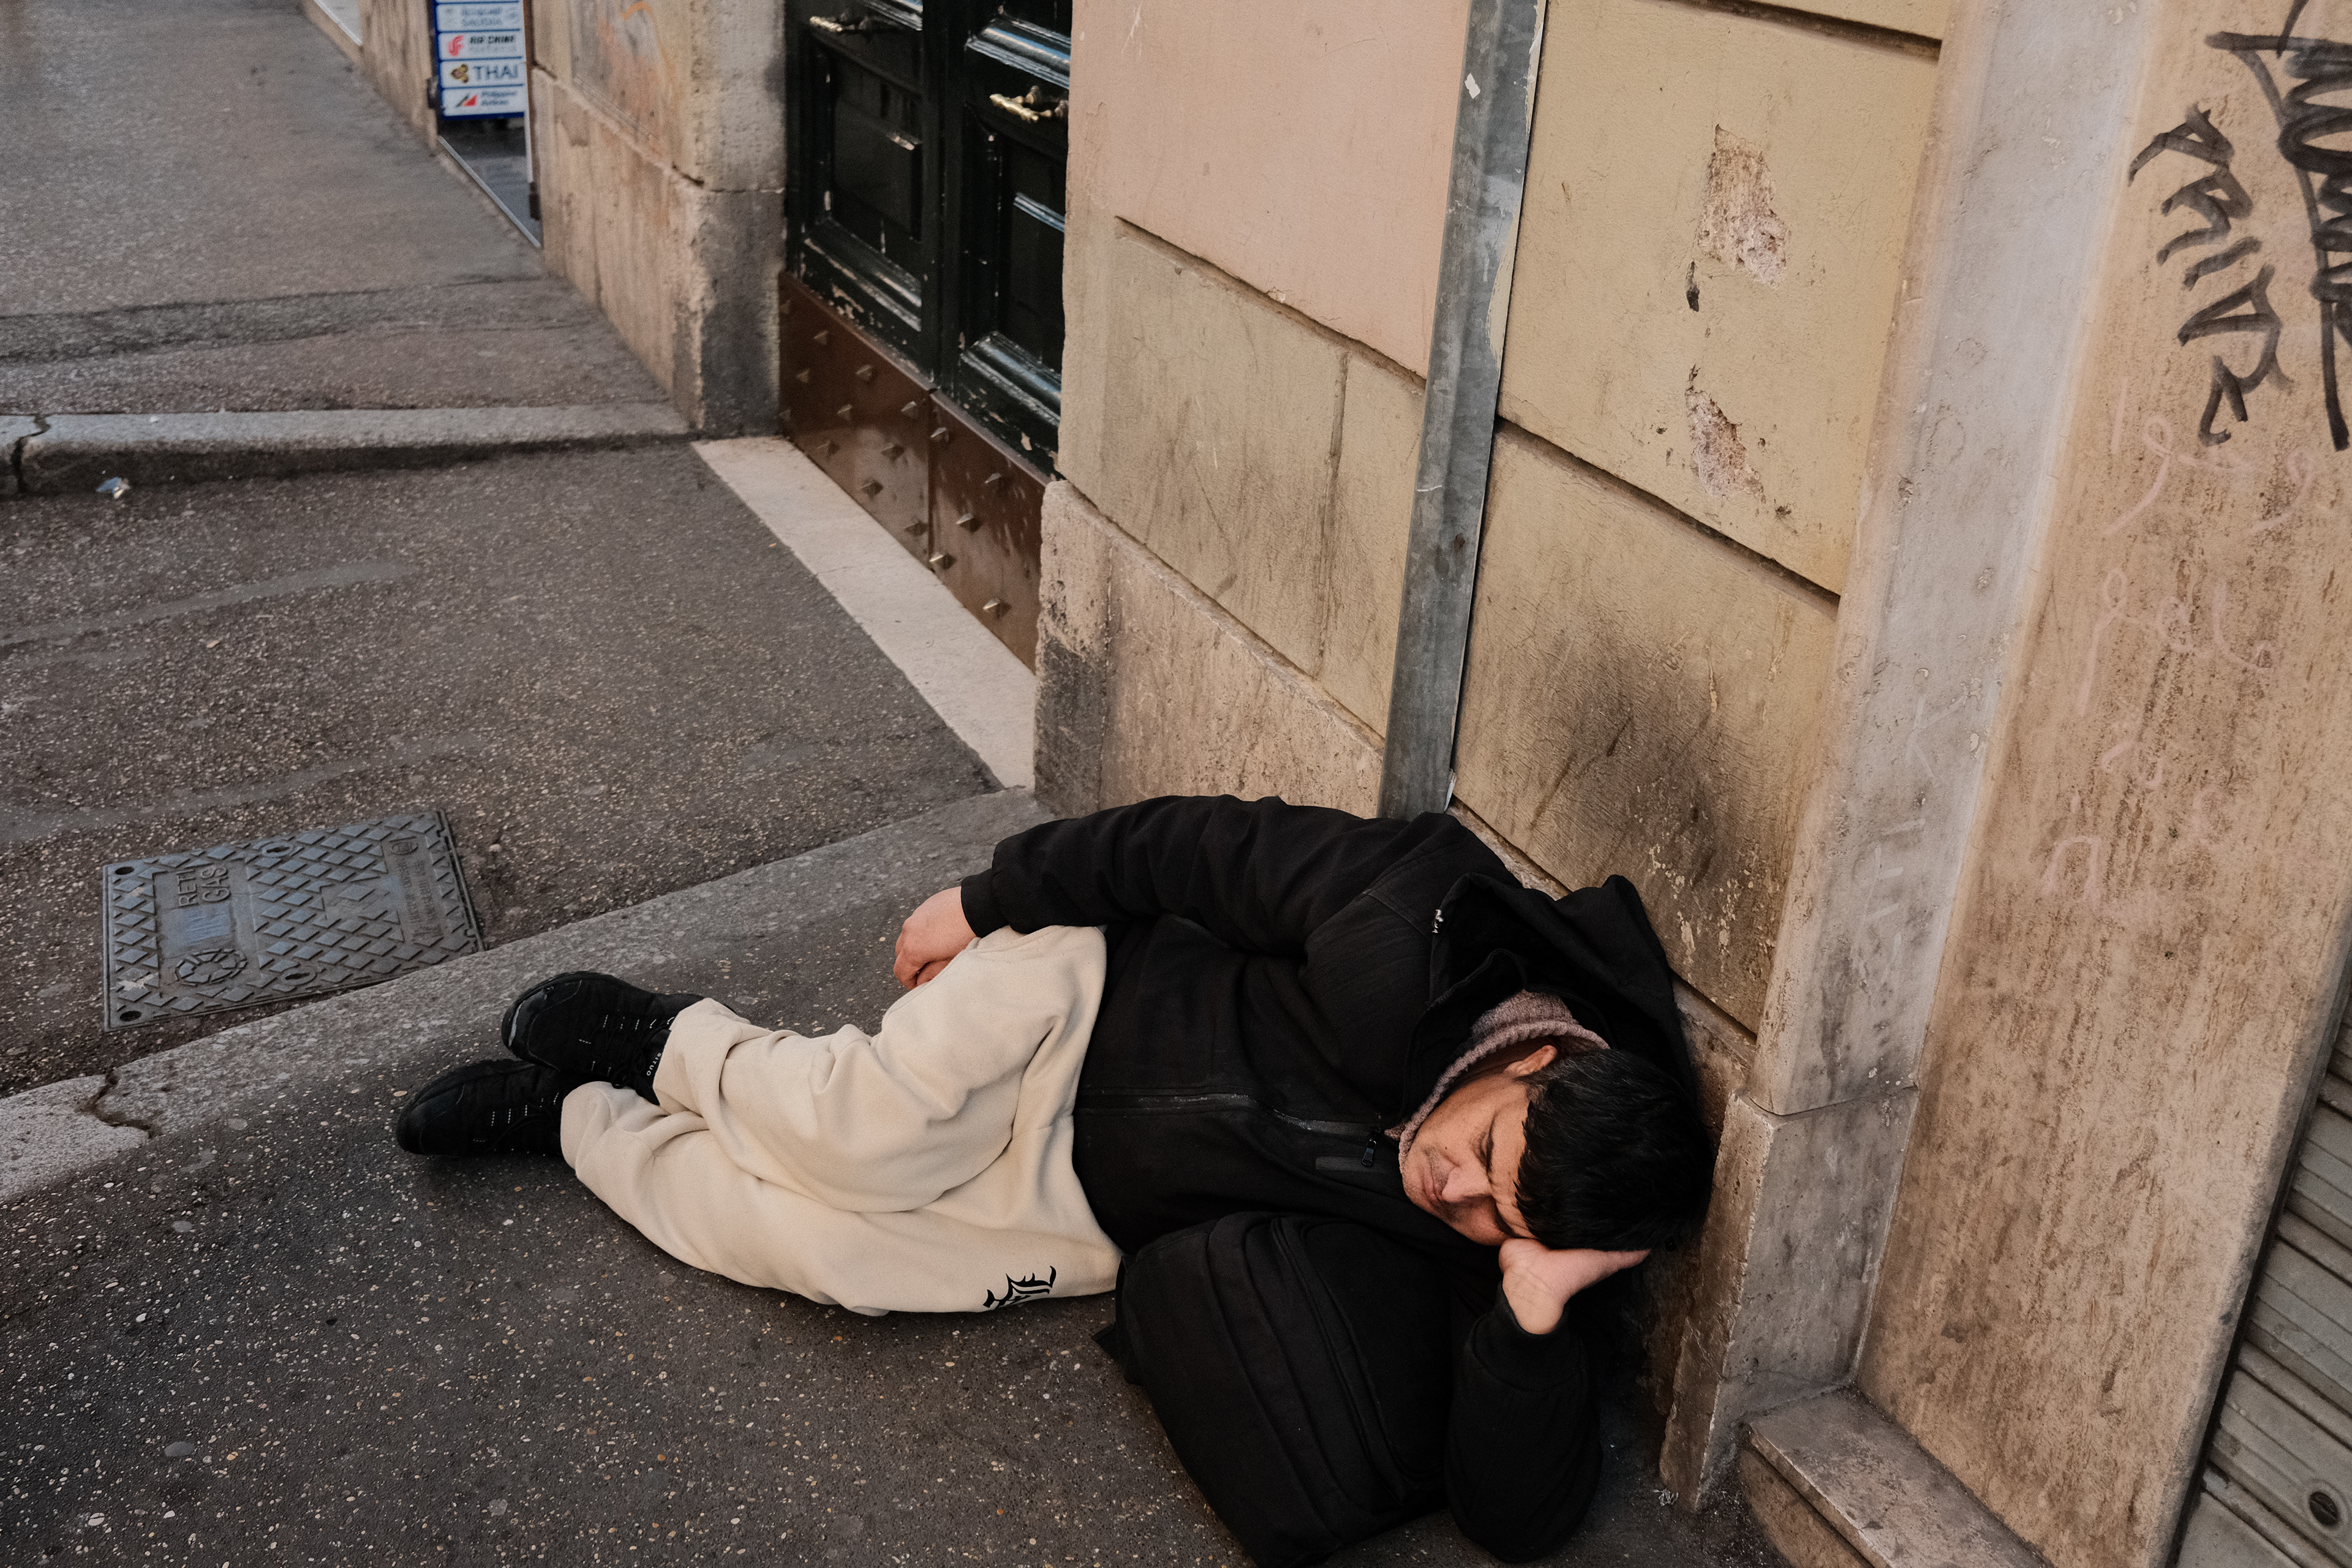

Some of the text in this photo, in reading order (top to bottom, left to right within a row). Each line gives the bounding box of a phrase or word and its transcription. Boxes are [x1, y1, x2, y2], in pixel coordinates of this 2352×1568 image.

[473, 64, 519, 80] THAI
[176, 869, 198, 908] RETI
[200, 864, 232, 903] GAS
